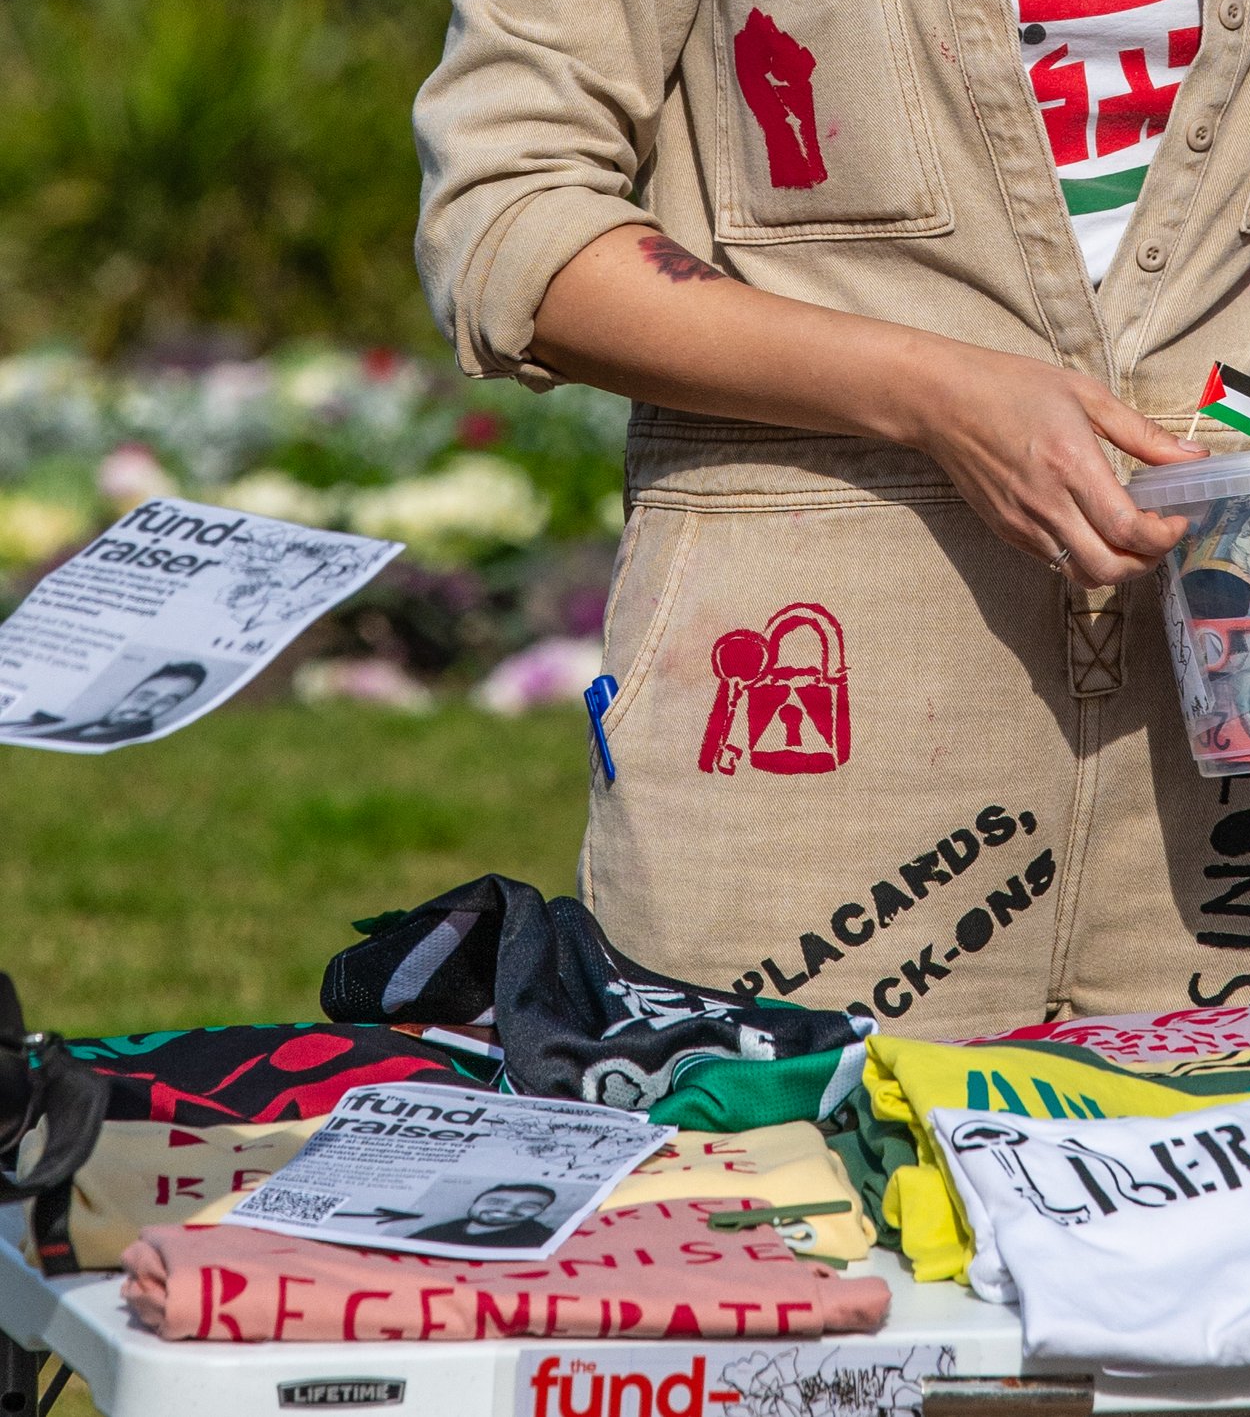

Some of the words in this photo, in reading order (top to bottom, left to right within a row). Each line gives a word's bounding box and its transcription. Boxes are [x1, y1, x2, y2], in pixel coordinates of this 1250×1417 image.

[121, 501, 253, 548] fund-
[82, 537, 222, 577] raiser
[350, 1093, 505, 1125] fund-
[331, 1116, 492, 1143] raiser
[197, 1266, 813, 1342] REGENERATE
[570, 1358, 597, 1374] the
[293, 1384, 390, 1403] LIFETIME
[530, 1355, 740, 1417] fund-
